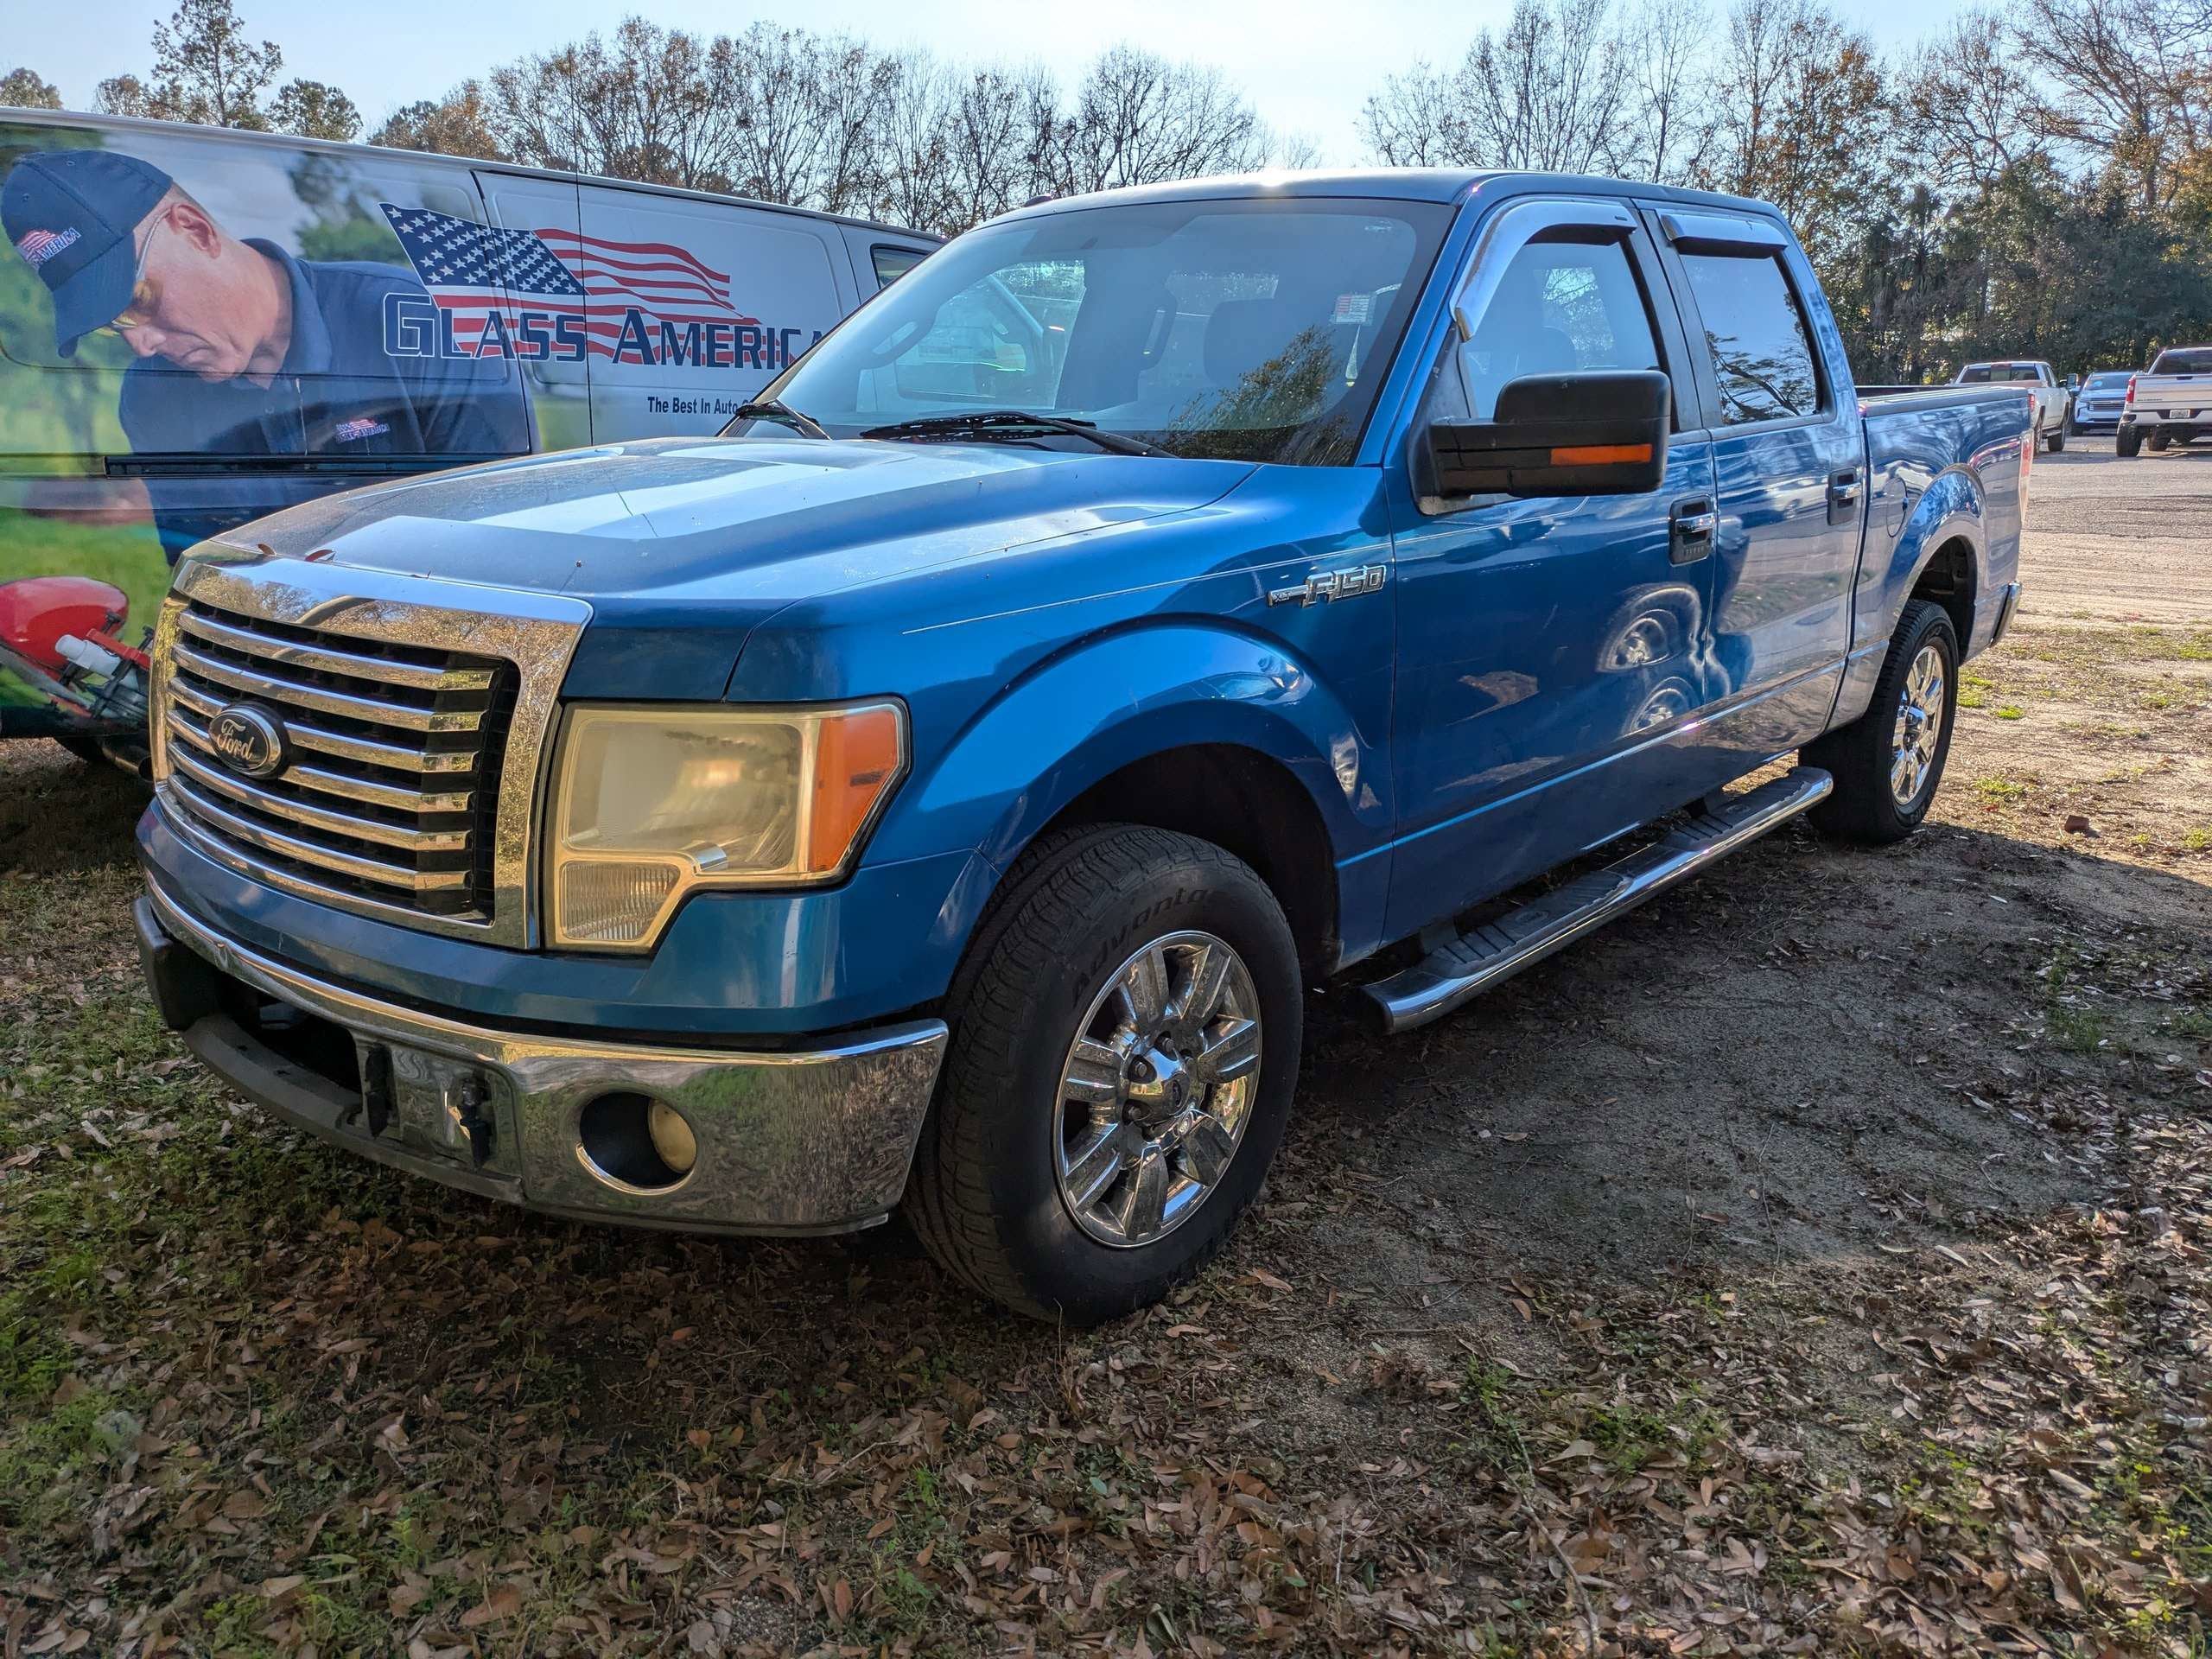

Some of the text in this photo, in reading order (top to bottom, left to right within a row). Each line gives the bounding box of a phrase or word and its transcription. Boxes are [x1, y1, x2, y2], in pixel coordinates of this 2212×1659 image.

[384, 293, 823, 370] GLASS AMERIC
[647, 397, 669, 413] The
[672, 397, 697, 414] Best
[701, 397, 711, 414] In
[714, 398, 739, 415] Auto
[217, 719, 255, 760] Ford
